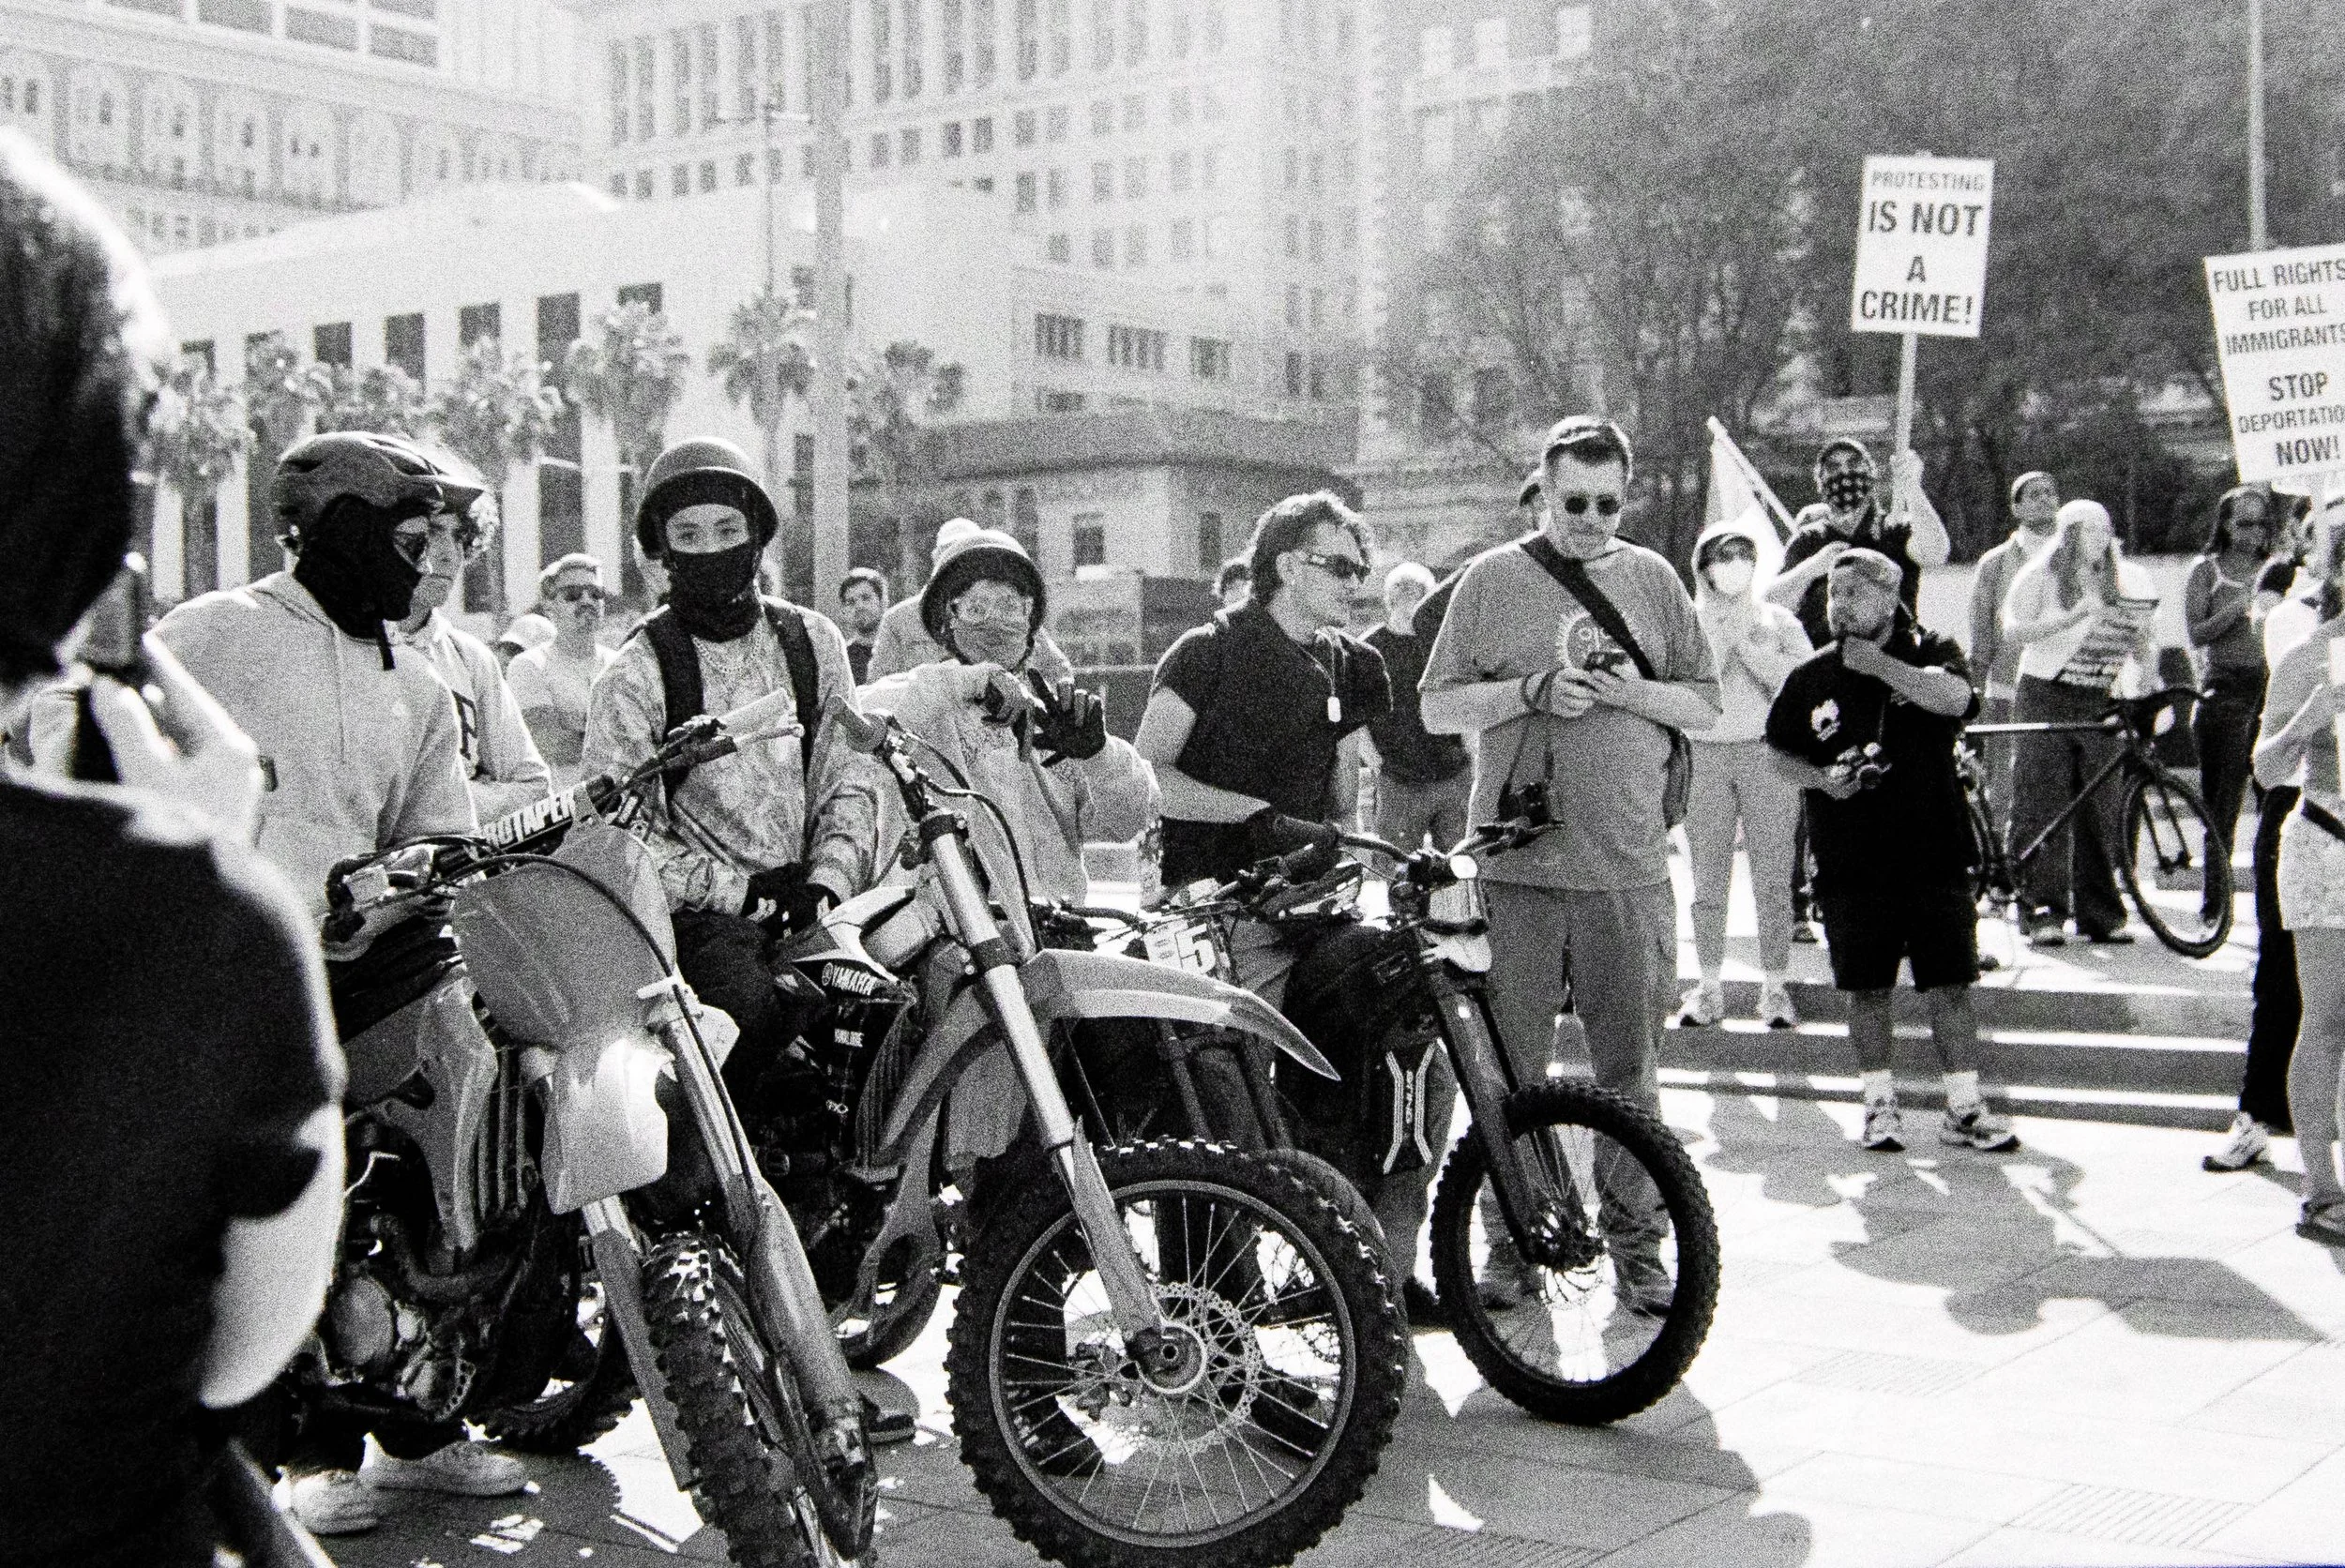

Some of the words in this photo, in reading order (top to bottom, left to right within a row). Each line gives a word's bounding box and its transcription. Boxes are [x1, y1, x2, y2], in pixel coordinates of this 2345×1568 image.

[1871, 171, 1986, 191] PROTESTING
[1868, 200, 1898, 234] IS
[1911, 202, 1984, 236] NOT
[1906, 254, 1927, 283] A
[2212, 266, 2266, 293] FULL
[2273, 257, 2345, 286] RIGHTS
[1859, 289, 1974, 325] CRIME!
[2248, 296, 2288, 321] FOR
[2294, 294, 2327, 316] ALL
[2268, 371, 2329, 402] STOP
[2276, 434, 2341, 467] NOW!
[478, 788, 575, 848] ROTAPER
[832, 963, 877, 996] YAMAHA
